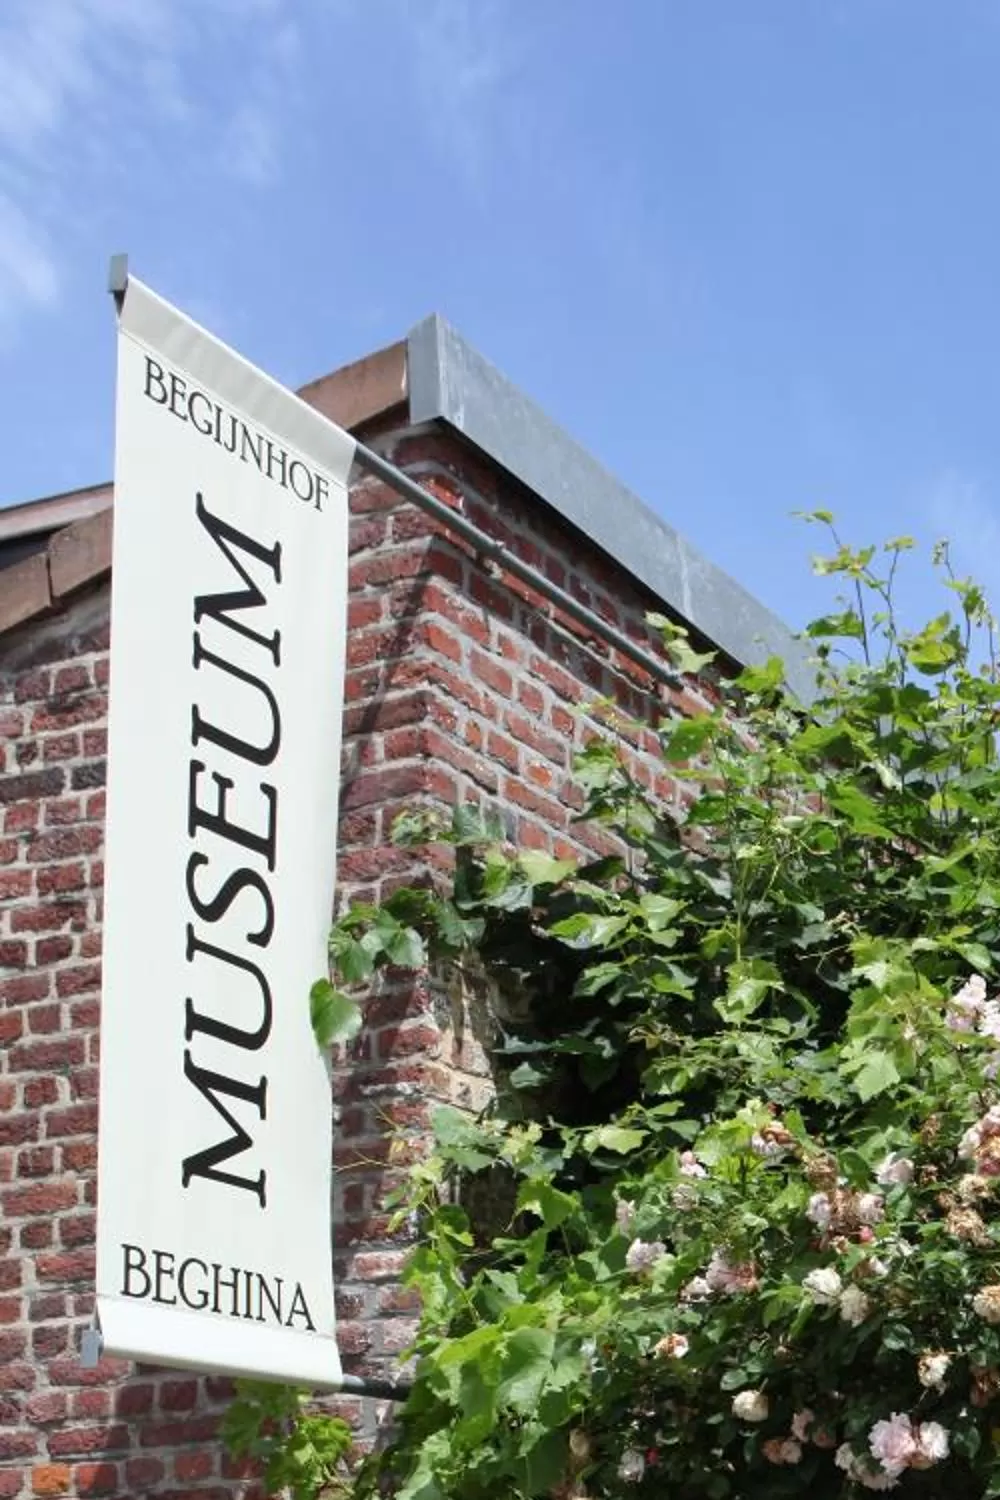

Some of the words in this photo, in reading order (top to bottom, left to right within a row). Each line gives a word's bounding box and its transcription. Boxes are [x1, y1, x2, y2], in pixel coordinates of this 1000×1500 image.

[144, 355, 330, 512] BEGIJNHOF
[182, 491, 283, 1209] MUSEUM
[121, 1243, 316, 1332] BEGHINA
